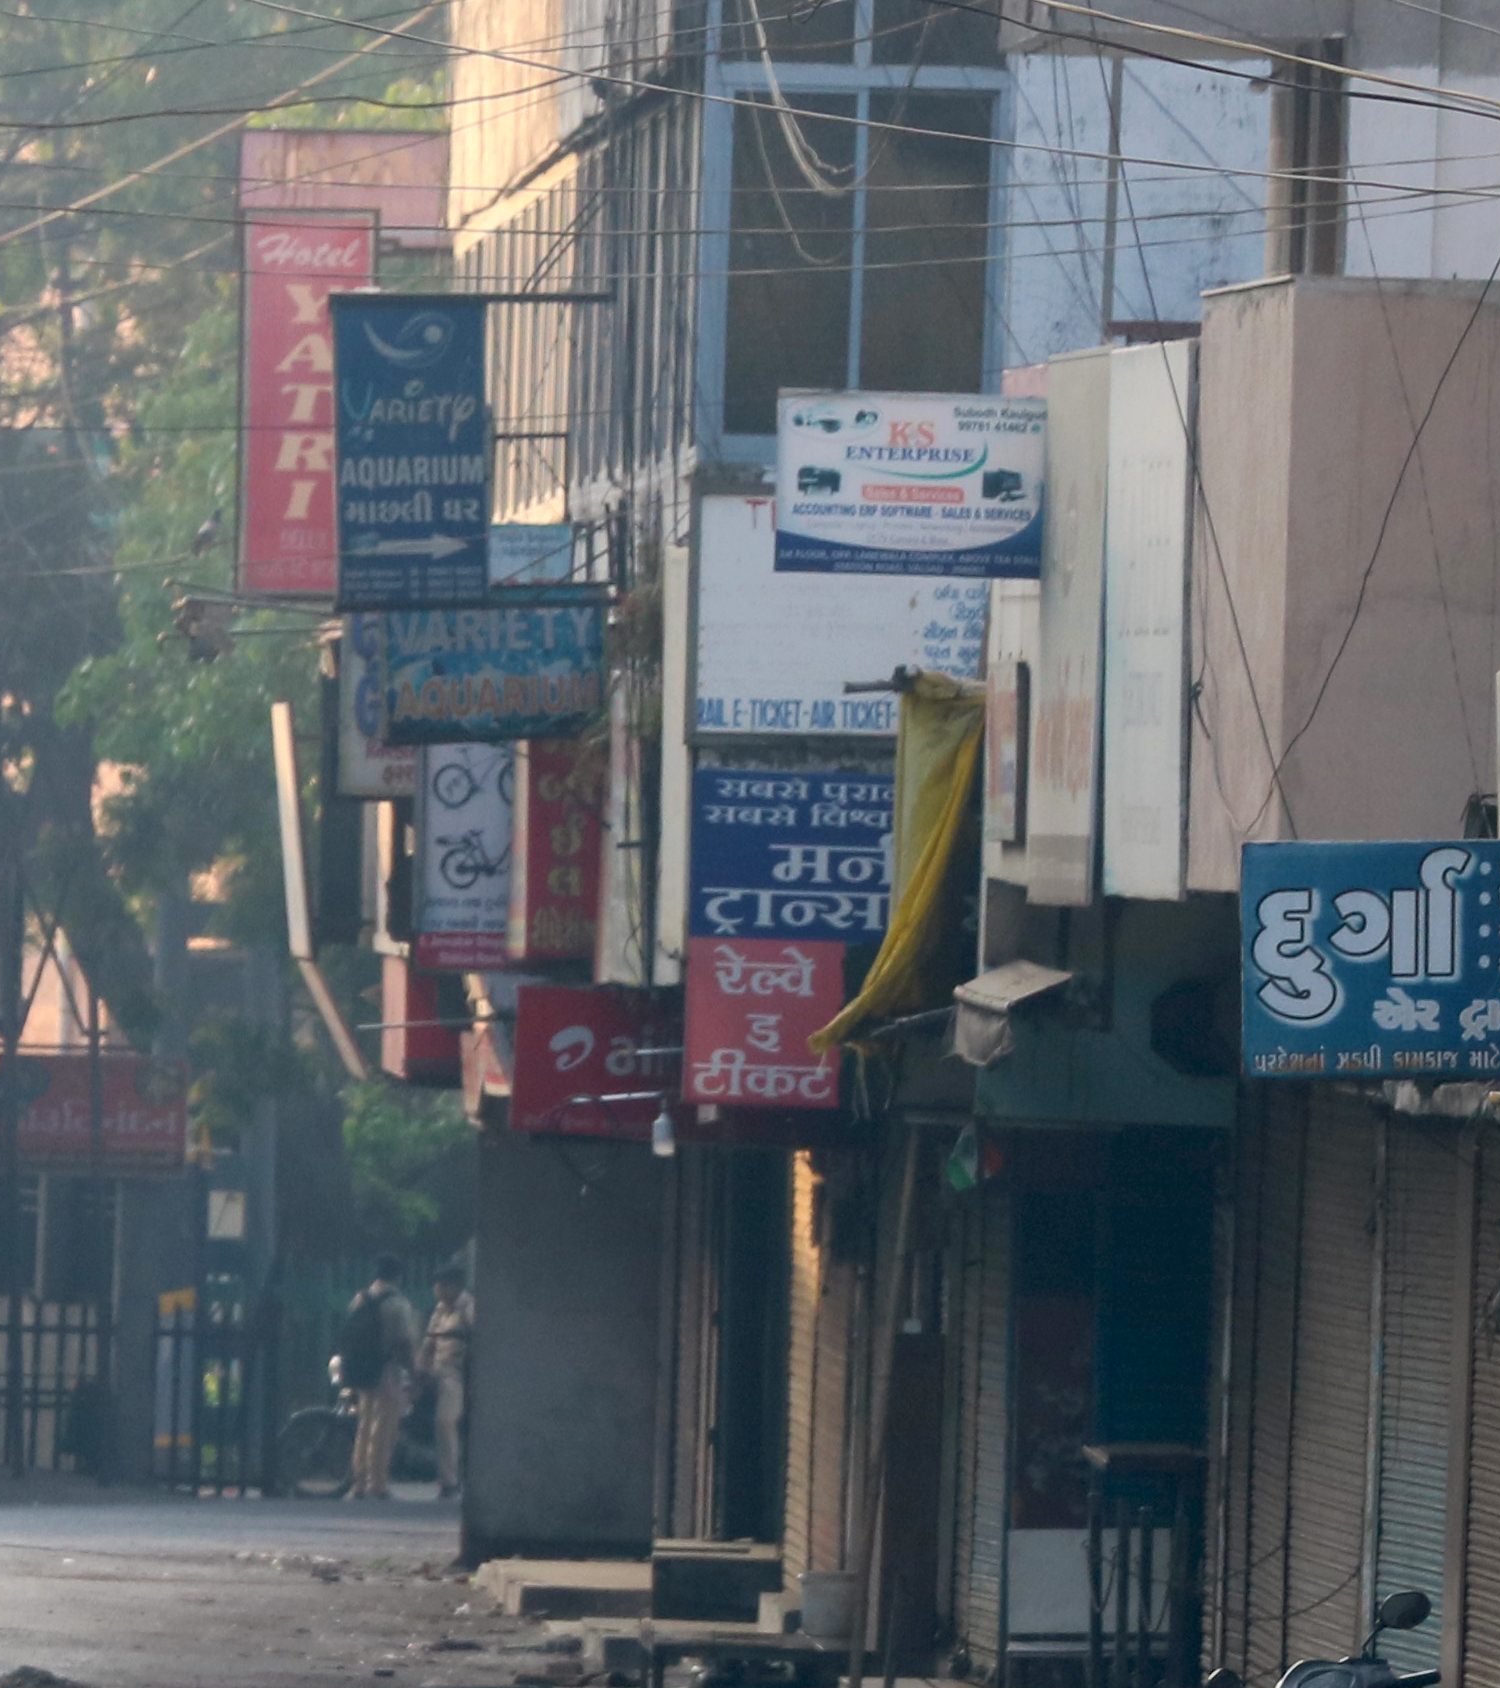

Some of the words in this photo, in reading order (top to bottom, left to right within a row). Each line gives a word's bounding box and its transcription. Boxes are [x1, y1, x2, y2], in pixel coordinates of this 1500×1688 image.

[257, 233, 362, 268] Hotel
[274, 284, 336, 519] YATRI
[340, 455, 485, 489] AQUARIUM
[845, 446, 975, 462] ENTERPRISE
[390, 608, 595, 651] VARIETY
[396, 672, 600, 720] AQUARIUM
[1251, 847, 1472, 1023] દુર્ગા
[714, 944, 816, 997] रेल्वे
[1371, 987, 1440, 1032] એર
[746, 1013, 782, 1052] इ
[1469, 1043, 1500, 1070] માટે
